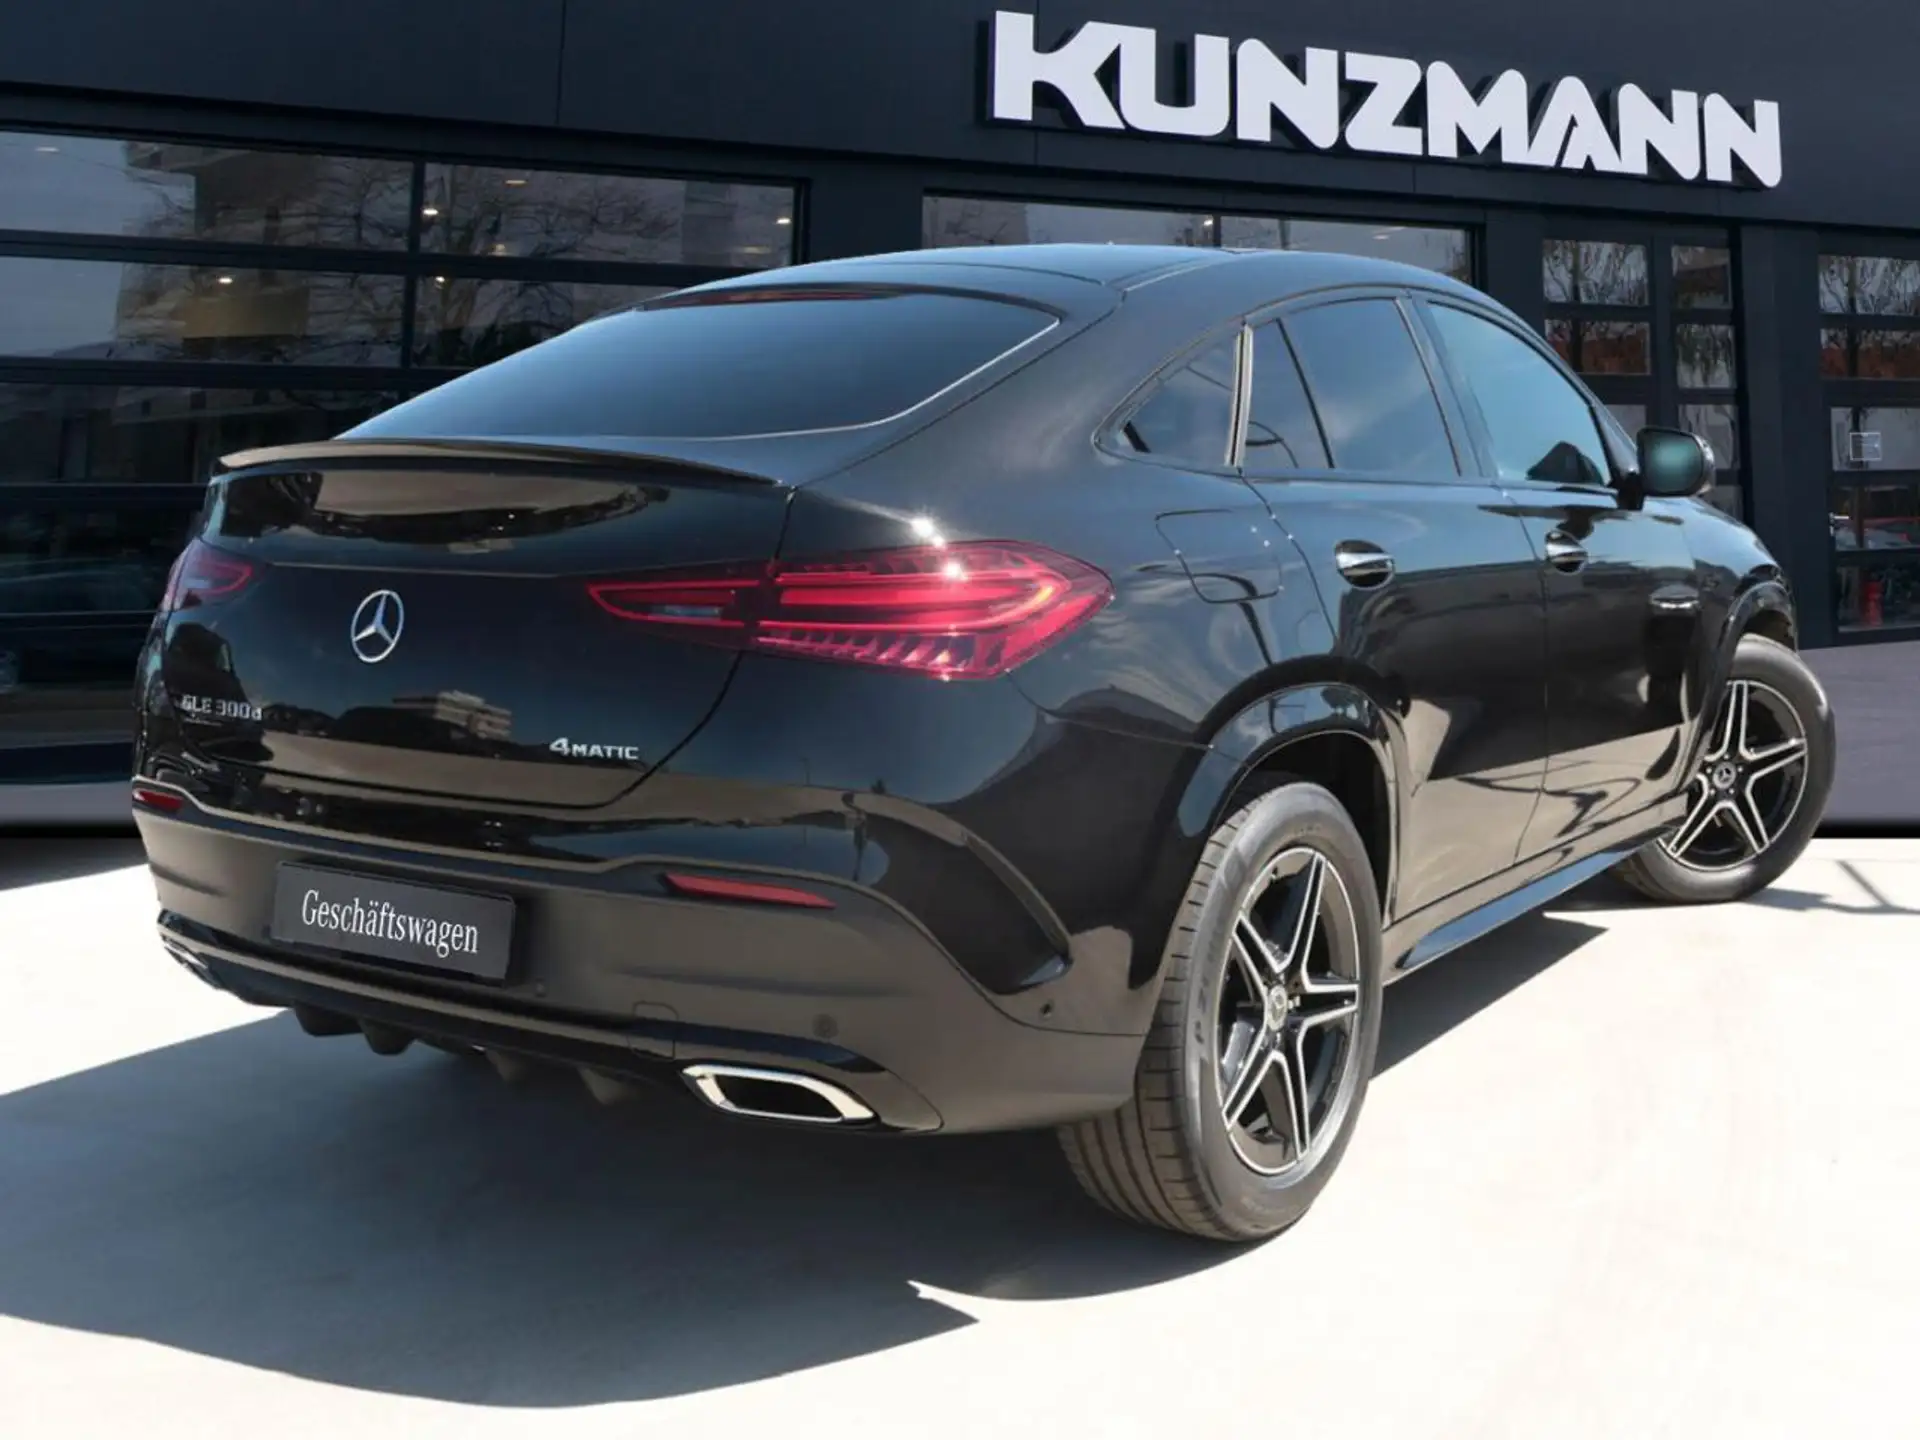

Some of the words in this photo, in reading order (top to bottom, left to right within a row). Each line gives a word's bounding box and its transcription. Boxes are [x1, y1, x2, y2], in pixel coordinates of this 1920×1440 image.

[993, 10, 1783, 188] KUNZMANN
[180, 694, 212, 714] GLE
[549, 737, 639, 760] 4MATIC
[301, 889, 479, 959] Geschäftswagen
